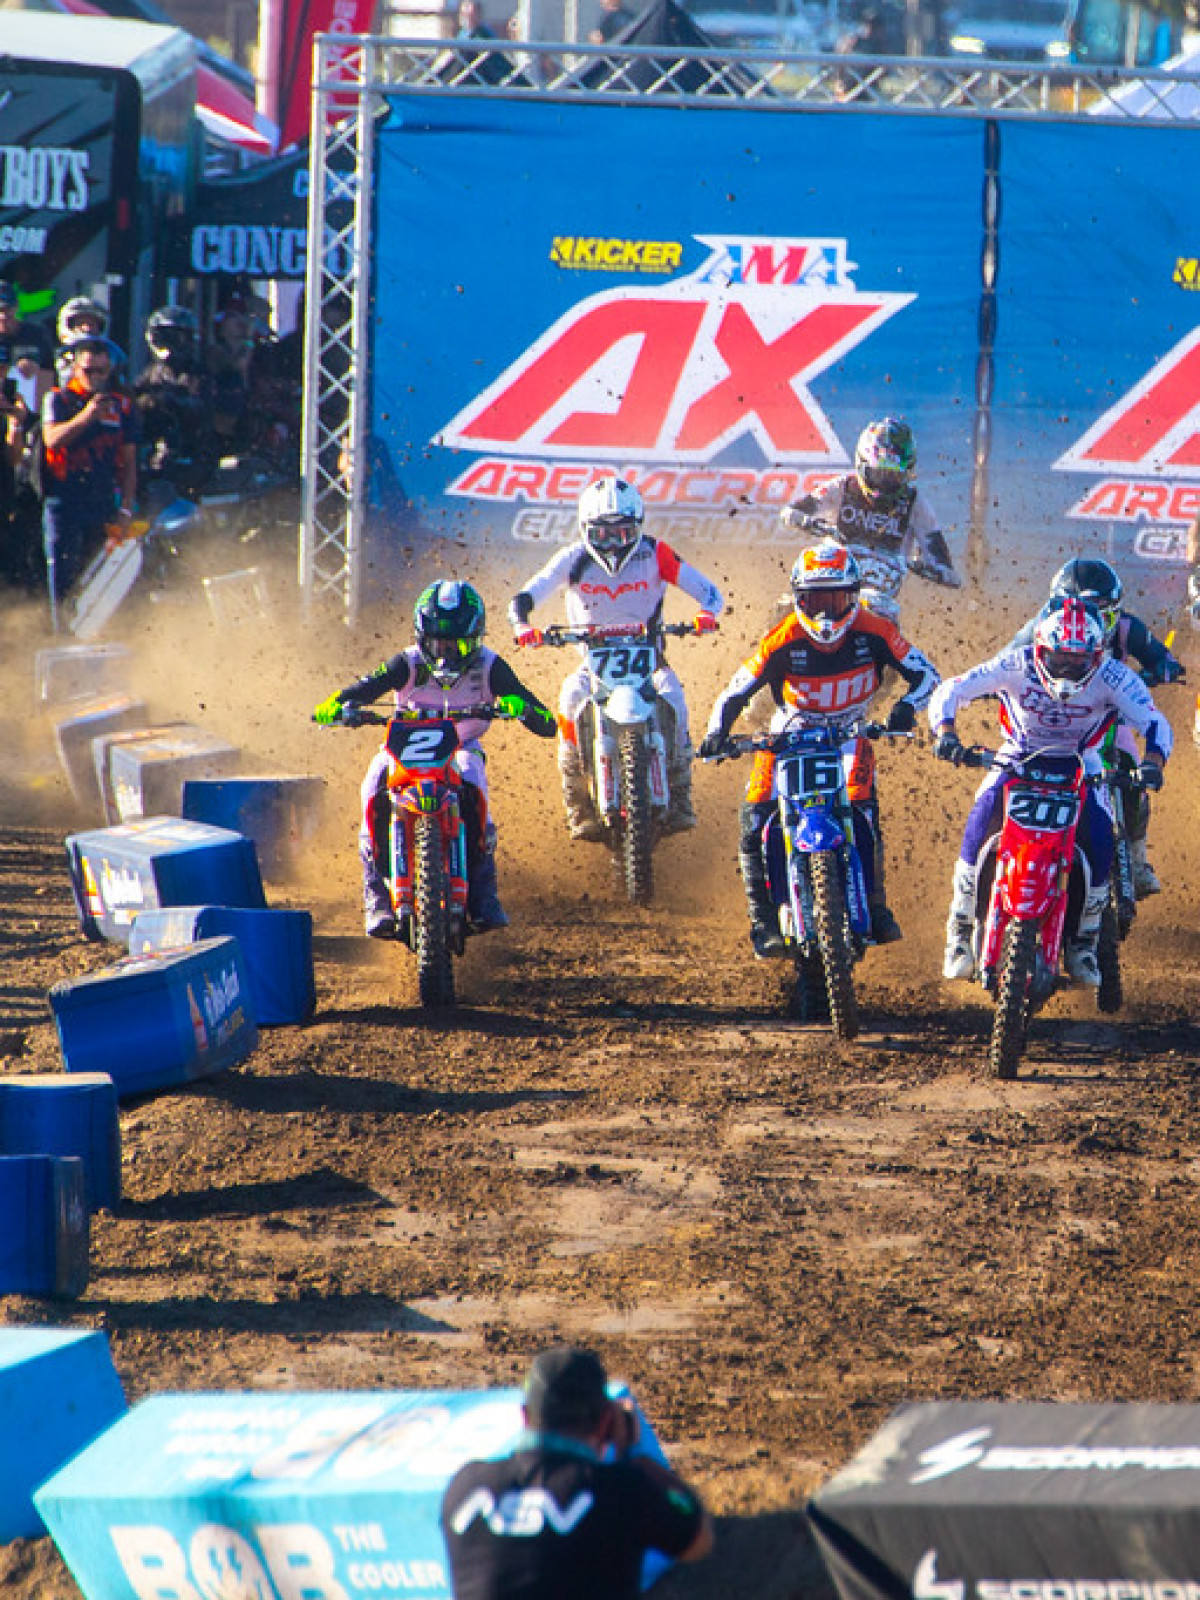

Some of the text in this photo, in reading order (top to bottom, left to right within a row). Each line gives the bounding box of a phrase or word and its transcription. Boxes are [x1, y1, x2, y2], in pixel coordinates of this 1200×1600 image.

[0, 146, 90, 211] BOYS
[573, 237, 683, 267] KICKER
[700, 244, 846, 285] AMA
[460, 299, 884, 452] AX
[592, 649, 650, 678] 734
[400, 729, 444, 761] 2
[782, 756, 840, 794] 16
[1009, 793, 1078, 827] 200
[333, 1523, 387, 1551] THE
[349, 1560, 447, 1588] COOLER
